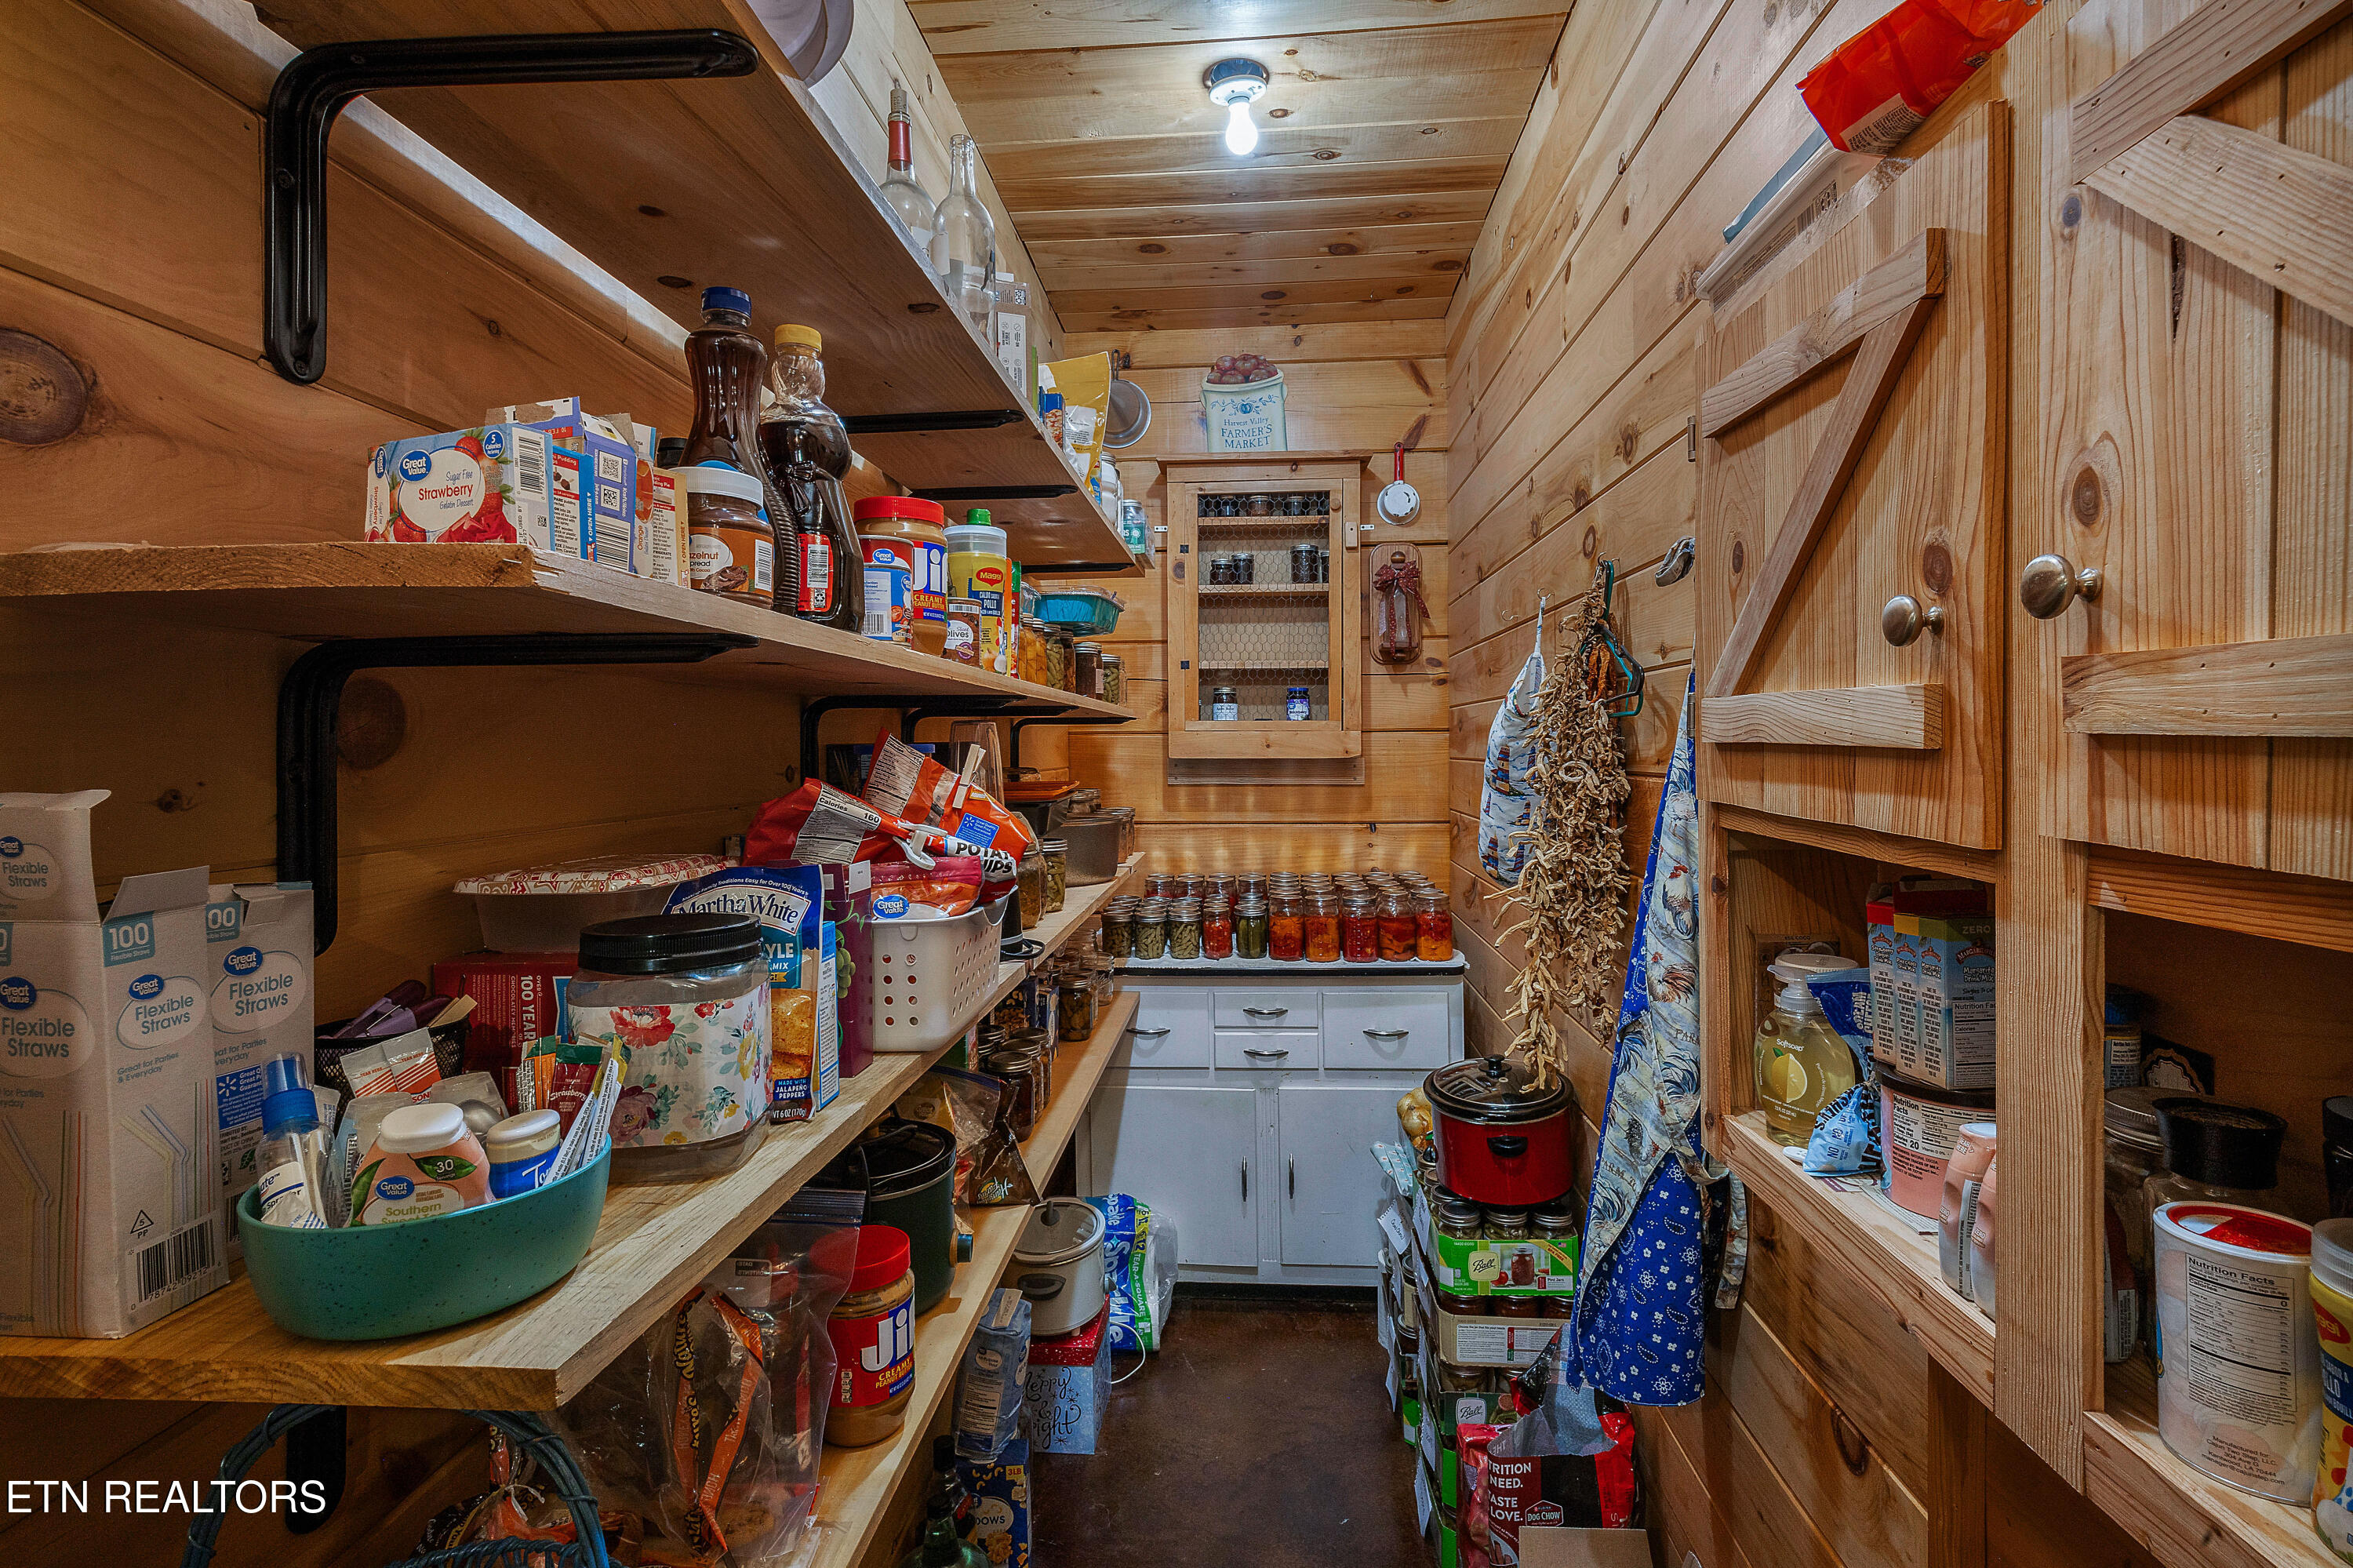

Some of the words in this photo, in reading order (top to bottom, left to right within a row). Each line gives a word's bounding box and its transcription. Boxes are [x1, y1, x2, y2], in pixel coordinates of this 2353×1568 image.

[1221, 424, 1272, 438] FARMER'S
[491, 435, 496, 443] 5
[1225, 435, 1270, 449] MARKET
[402, 457, 427, 469] Great
[558, 456, 577, 465] Pudding
[409, 466, 427, 475] Value
[446, 471, 461, 485] Sugar
[463, 470, 473, 479] Free
[419, 484, 474, 500] Strawberry
[439, 501, 455, 510] Gelatin
[456, 499, 474, 508] Dessert
[689, 551, 718, 560] zelnut
[980, 572, 1002, 580] Maggi
[915, 594, 943, 604] CREAMY
[984, 599, 997, 609] POLLO
[887, 740, 904, 753] Calories
[820, 798, 847, 812] Calories
[864, 813, 879, 823] 160
[0, 841, 19, 850] Great
[2, 862, 49, 875] Flexible
[8, 875, 47, 887] Straws
[747, 893, 798, 923] White
[878, 900, 904, 909] Great
[207, 907, 236, 929] 00
[109, 922, 149, 950] 100
[1962, 925, 1991, 935] ZERO
[765, 944, 794, 959] YLE
[1871, 944, 1894, 955] Strawberry
[228, 953, 256, 965] Great
[235, 961, 258, 970] Value
[1922, 962, 1941, 972] Margarita
[1963, 966, 1995, 976] Margarita
[132, 978, 158, 991] Great
[1963, 973, 1980, 983] Drink
[1, 984, 30, 996] Great
[139, 986, 159, 995] Value
[229, 974, 293, 1000] Flexible
[521, 976, 533, 1000] 100
[7, 995, 31, 1003] Value
[235, 992, 289, 1017] Straws
[136, 995, 195, 1020] Flexible
[2, 1018, 75, 1038] Flexible
[141, 1011, 191, 1035] Straws
[523, 1006, 536, 1039] YEAR
[8, 1039, 70, 1057] Straws
[242, 1038, 267, 1051] Parties
[1776, 1038, 1803, 1052] Softsoap
[117, 1065, 141, 1075] Great
[155, 1052, 179, 1066] Parties
[215, 1052, 249, 1066] veryday
[125, 1065, 162, 1082] Everyday
[240, 1082, 262, 1091] Guarant
[550, 1090, 587, 1101] Strawberry
[1893, 1095, 1919, 1111] Nutrition
[1893, 1104, 1909, 1115] Facts
[792, 1108, 806, 1118] (170g)
[1894, 1133, 1908, 1143] Calories
[1910, 1140, 1919, 1150] 20
[1827, 1146, 1839, 1159] NO
[436, 1162, 453, 1173] 30
[380, 1181, 407, 1191] Great
[386, 1202, 441, 1216] Southern
[1974, 1228, 1986, 1239] ZERO
[1136, 1241, 1145, 1252] 12
[1473, 1259, 1496, 1273] Ball
[2188, 1257, 2237, 1279] Nutrition
[2241, 1272, 2275, 1286] Facts
[150, 1285, 177, 1301] 78742
[181, 1268, 207, 1285] 09212
[2215, 1272, 2238, 1284] servings
[1132, 1253, 1146, 1317] TEAR-A-SQUARE
[2189, 1278, 2218, 1293] Calories
[878, 1357, 911, 1381] CREAMY
[875, 1375, 898, 1388] PEANUT
[1038, 1401, 1051, 1419] &
[1460, 1404, 1483, 1419] Ball
[2206, 1438, 2225, 1450] Cajun
[2227, 1444, 2242, 1453] Two
[2242, 1450, 2260, 1461] Step,
[2262, 1455, 2278, 1466] LLC.
[2213, 1435, 2260, 1457] Manufactured
[2208, 1450, 2242, 1468] Kentwood,
[2243, 1464, 2253, 1472] LA
[2254, 1466, 2277, 1479] 70444
[2238, 1455, 2252, 1464] Ave
[1489, 1461, 1532, 1475] TRITION
[2201, 1453, 2286, 1486] manager@cajunstep.com
[1489, 1479, 1523, 1489] NEED.
[1490, 1508, 1523, 1522] LOVE.
[1527, 1512, 1540, 1522] DOG
[1540, 1512, 1561, 1522] CHOW
